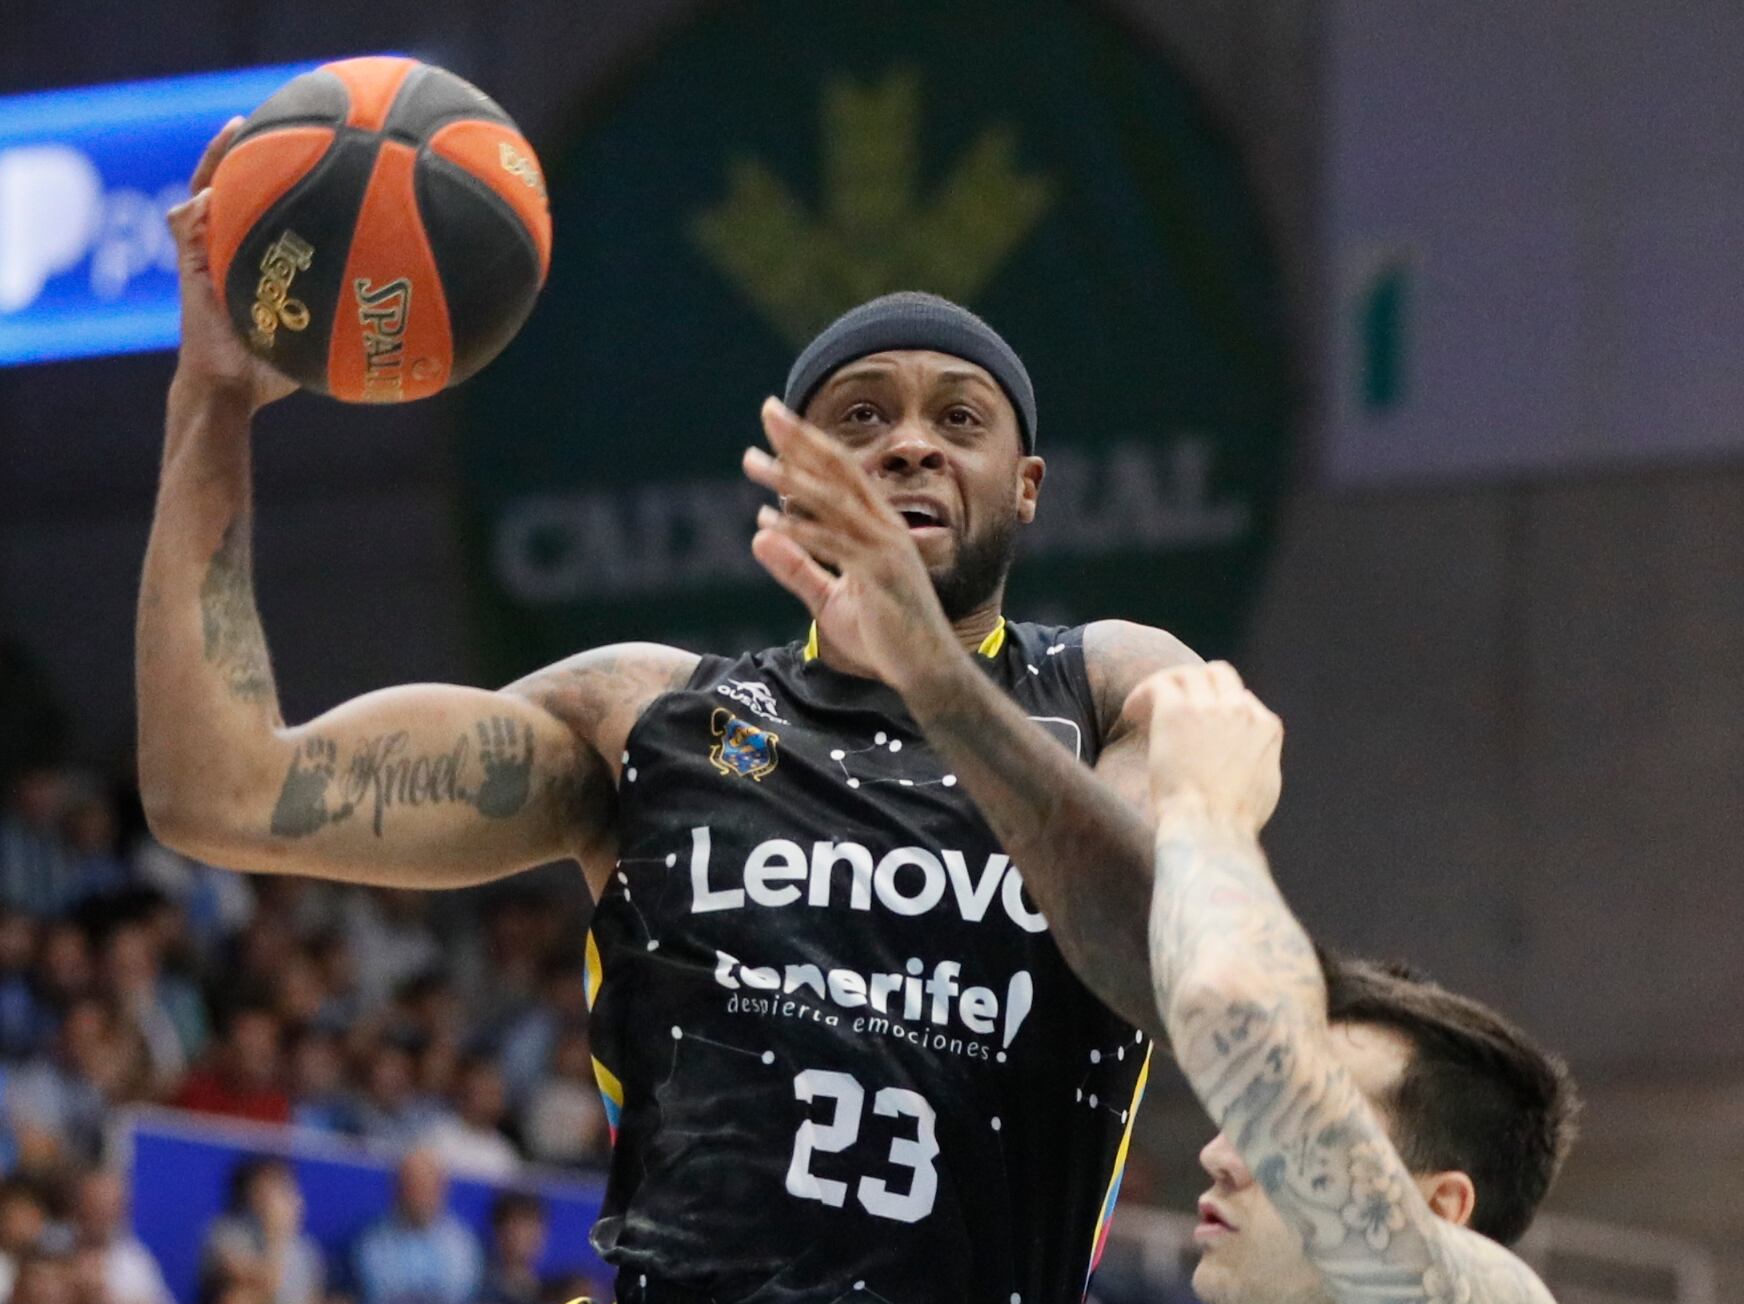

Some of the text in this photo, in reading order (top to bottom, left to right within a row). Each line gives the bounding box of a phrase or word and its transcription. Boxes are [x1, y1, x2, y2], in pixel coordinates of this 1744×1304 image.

[690, 826, 1049, 933] Lenovo
[727, 993, 989, 1060] despierta emociones
[785, 1068, 940, 1224] 23
